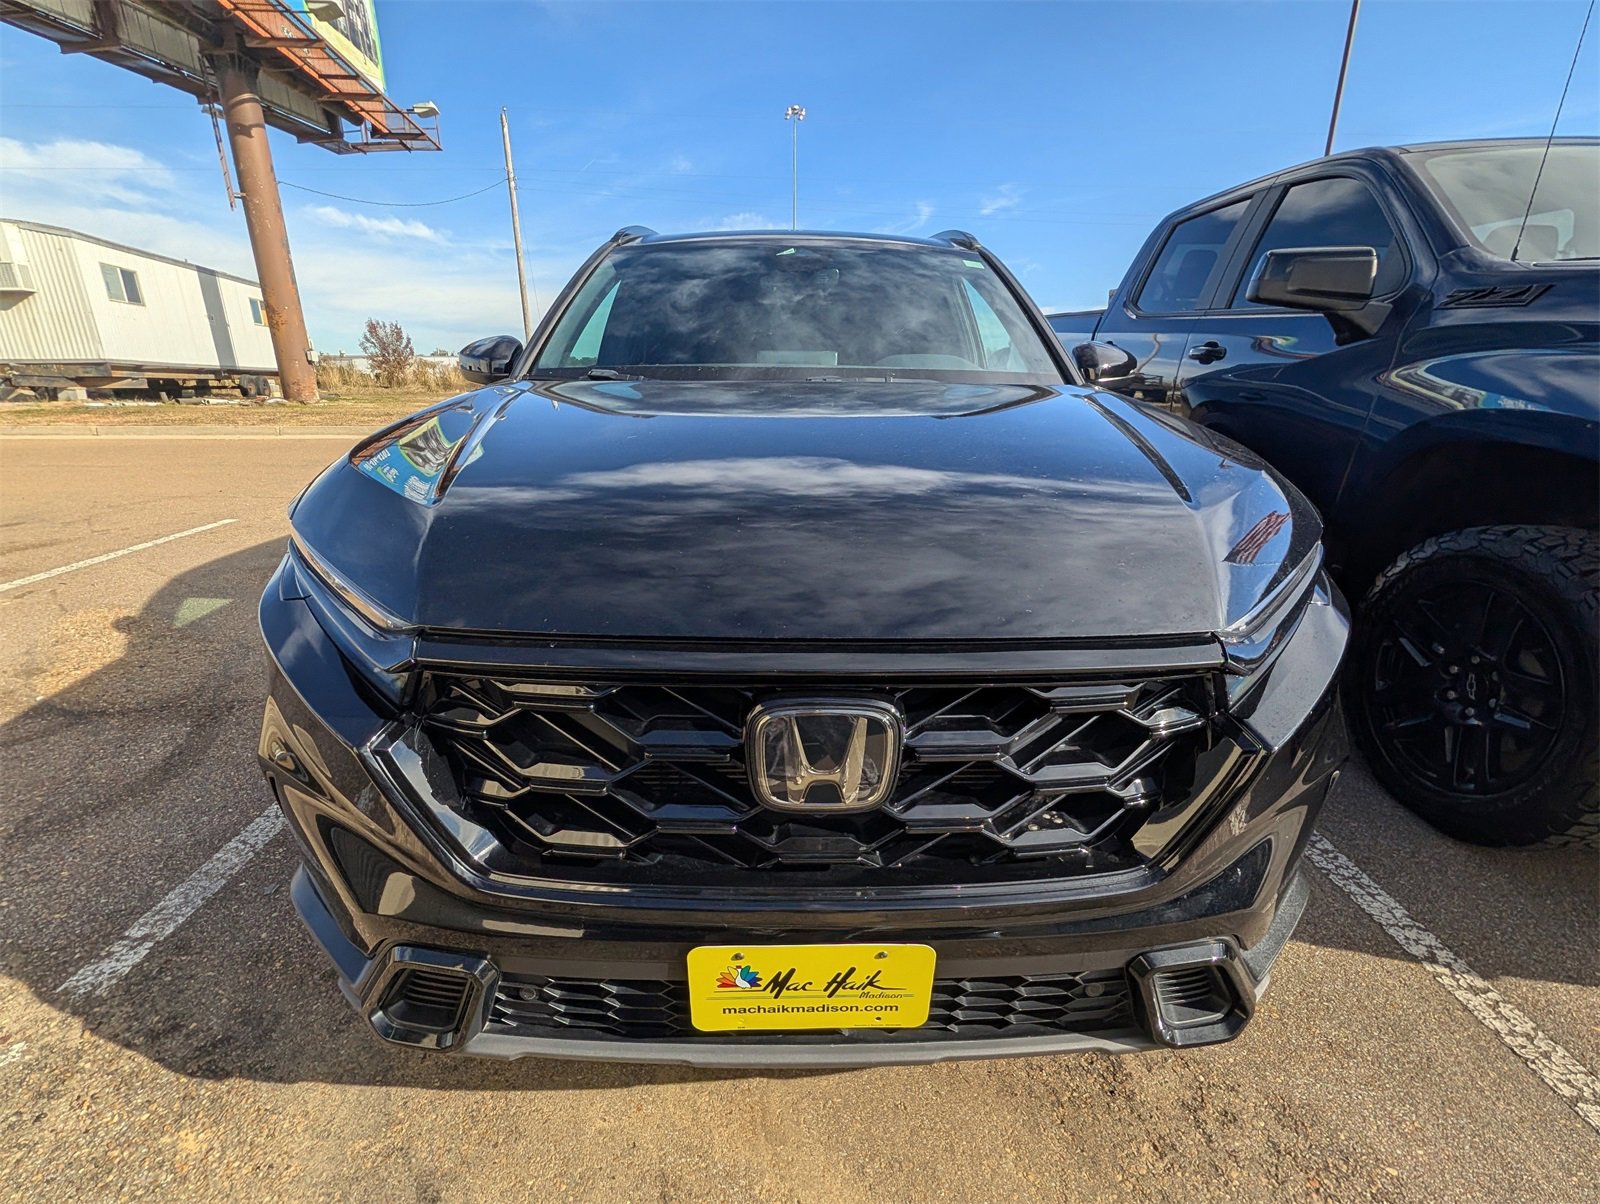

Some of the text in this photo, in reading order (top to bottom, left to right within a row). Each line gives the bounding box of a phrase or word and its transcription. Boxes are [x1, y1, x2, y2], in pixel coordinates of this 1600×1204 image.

[760, 966, 907, 999] Mac Haik
[858, 991, 903, 999] Madison
[722, 1003, 899, 1015] machaikmadison.com
